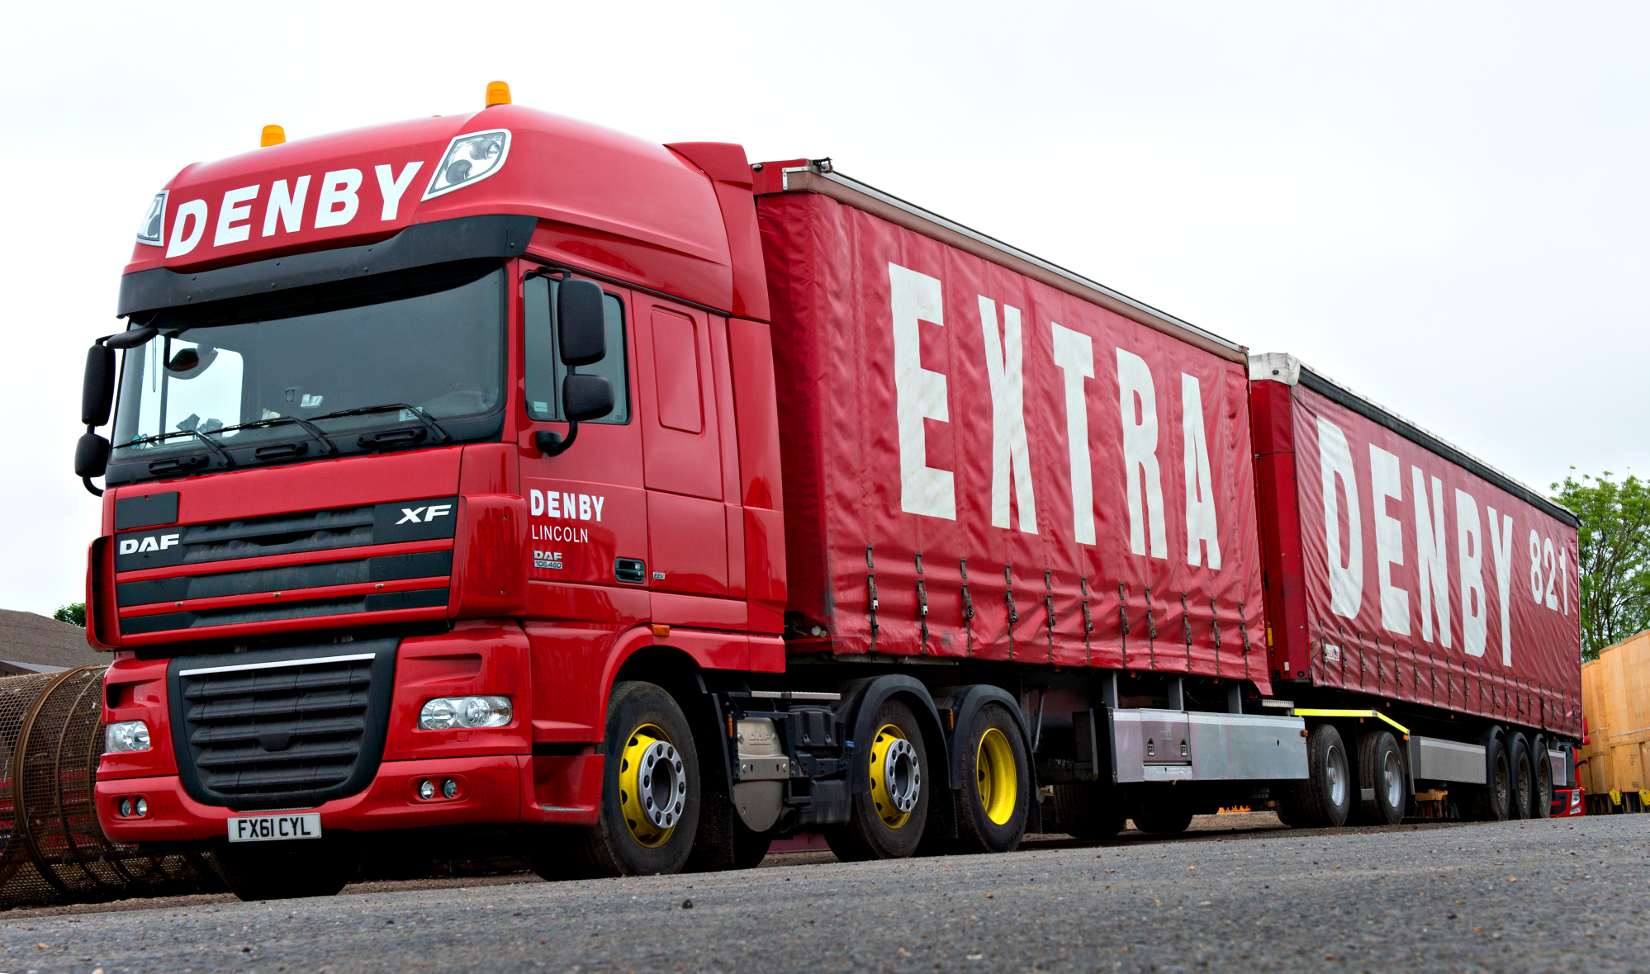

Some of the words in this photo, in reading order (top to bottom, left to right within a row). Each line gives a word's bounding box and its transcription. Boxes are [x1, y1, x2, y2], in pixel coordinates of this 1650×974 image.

[166, 161, 424, 259] DENBY
[888, 262, 1222, 571] EXTRA
[396, 505, 452, 525] XF
[530, 489, 605, 522] DENBY
[119, 533, 180, 555] DAF
[531, 524, 588, 543] LINCOLN
[1317, 415, 1514, 668] DENBY
[1529, 529, 1569, 616] 821
[533, 550, 562, 561] DAF
[238, 818, 274, 839] FX61
[279, 817, 311, 837] CYL
